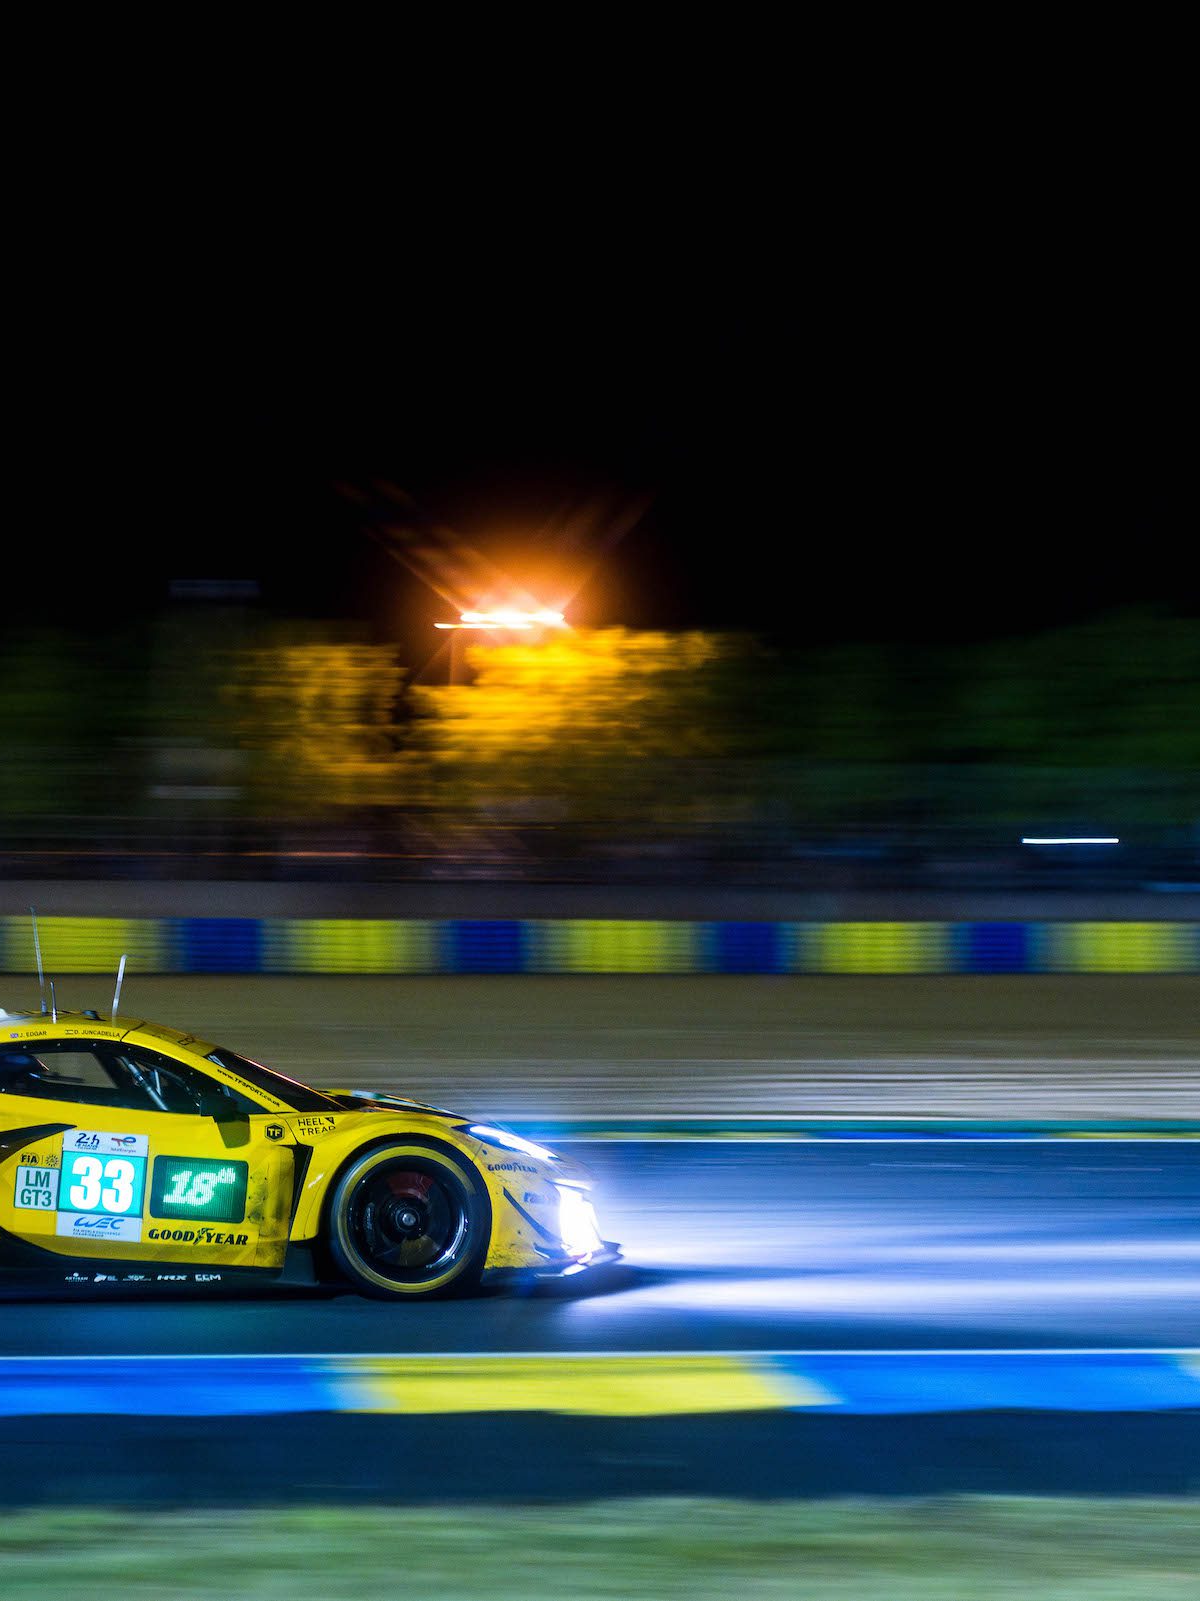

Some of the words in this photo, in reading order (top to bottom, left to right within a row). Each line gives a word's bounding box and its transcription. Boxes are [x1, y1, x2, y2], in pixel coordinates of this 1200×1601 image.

[81, 1030, 120, 1038] JUNCADELLA
[298, 1118, 325, 1127] HEEL
[25, 1170, 50, 1188] LM
[69, 1156, 135, 1213] 33
[21, 1188, 52, 1207] GT3
[73, 1216, 125, 1230] WEC
[148, 1227, 249, 1246] GOODYEAR
